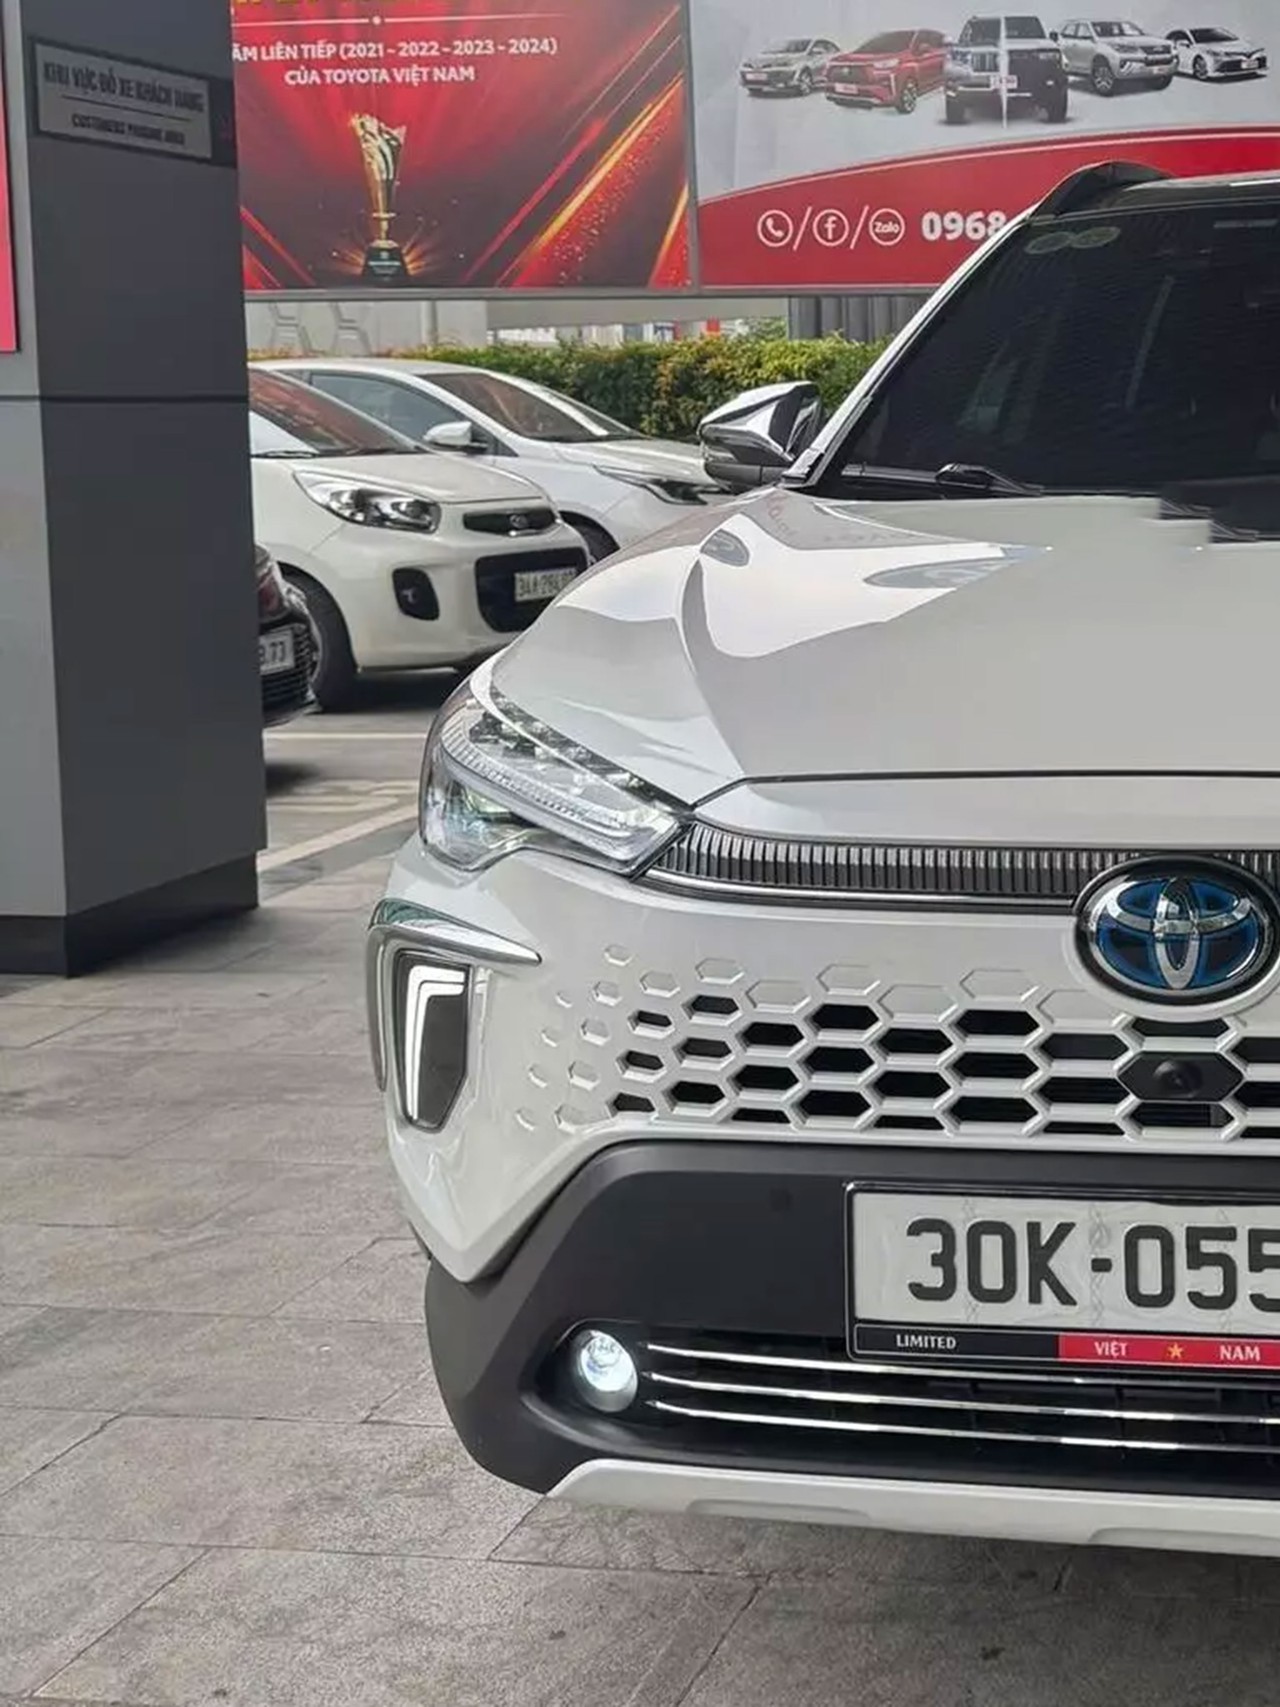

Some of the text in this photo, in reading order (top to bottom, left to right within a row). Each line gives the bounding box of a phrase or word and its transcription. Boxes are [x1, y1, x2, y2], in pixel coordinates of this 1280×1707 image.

[260, 41, 298, 61] LIÊN
[300, 39, 337, 59] TIẾP
[340, 42, 384, 60] (2021
[398, 42, 440, 58] 2022
[453, 41, 495, 56] 2023
[508, 38, 557, 56] 2024)
[284, 65, 475, 86] CỦA TOYOTA VIỆT NAM
[874, 223, 900, 233] Zalo
[895, 1333, 957, 1350] LIMITED
[1094, 1341, 1128, 1359] VIỆT
[1219, 1345, 1261, 1362] NAM
